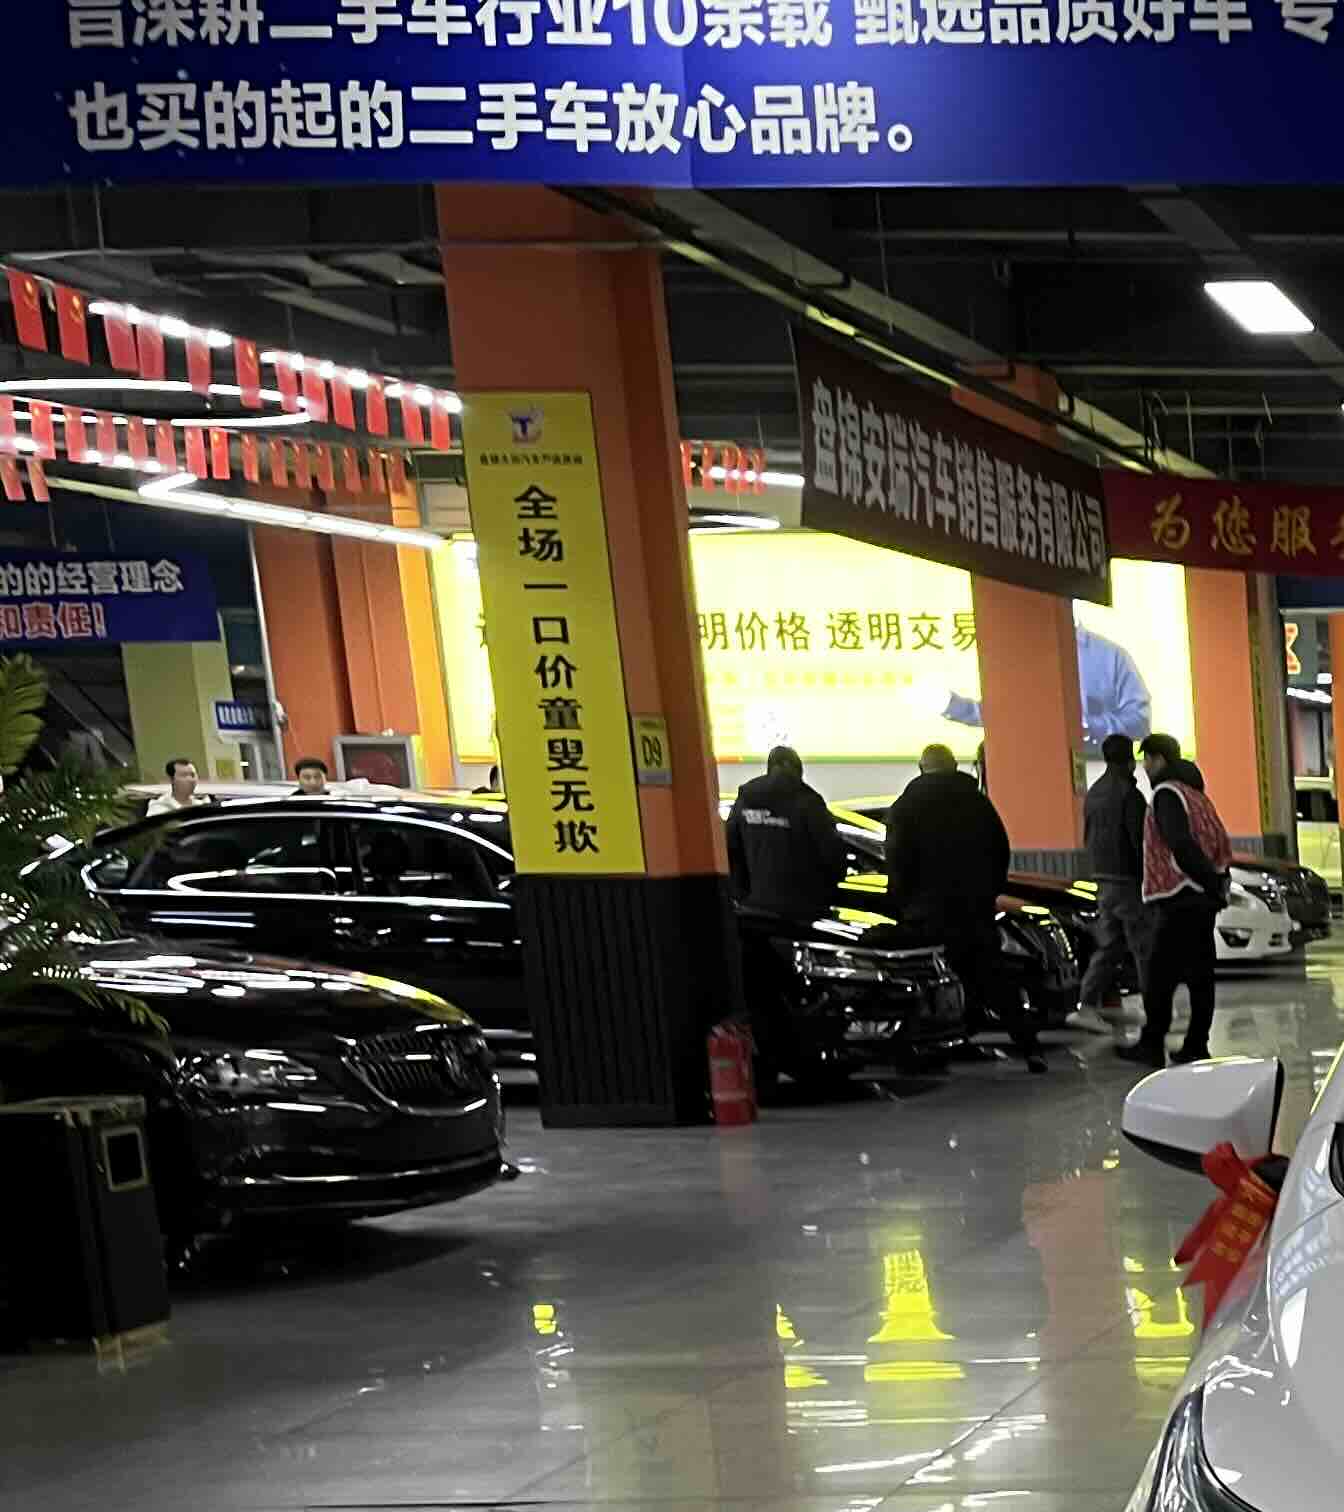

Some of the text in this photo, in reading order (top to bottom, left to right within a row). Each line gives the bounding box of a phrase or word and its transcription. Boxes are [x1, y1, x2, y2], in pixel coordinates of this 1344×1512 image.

[67, 79, 914, 155] 也买的起的二手车放心品牌。
[825, 611, 978, 652] 透明交易
[513, 484, 600, 854] 全场一口价童叟无欺
[641, 735, 662, 768] D9
